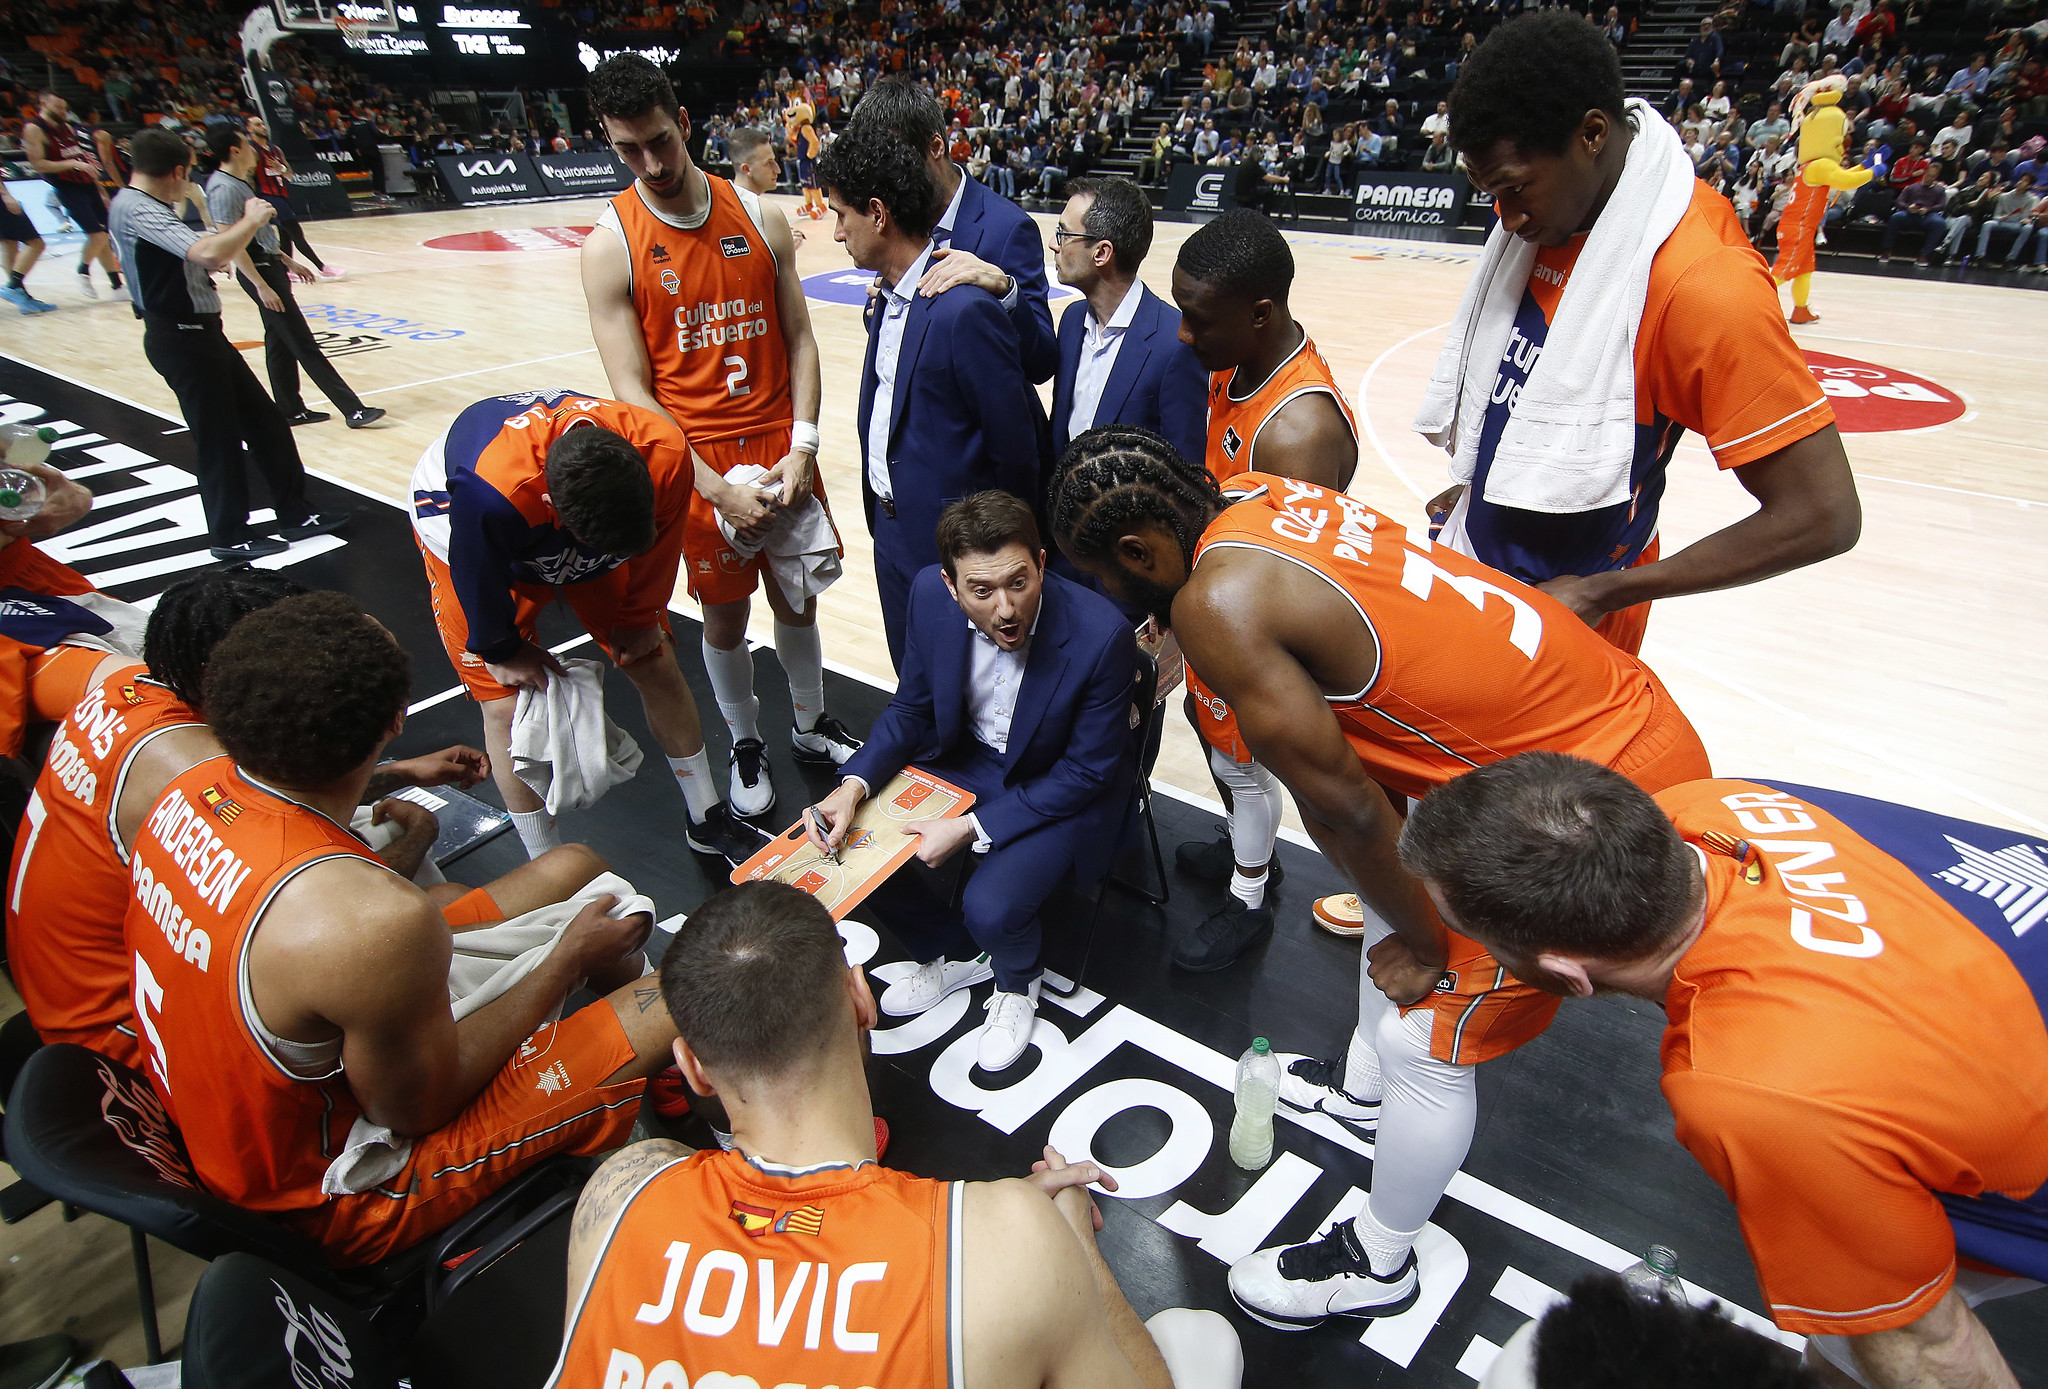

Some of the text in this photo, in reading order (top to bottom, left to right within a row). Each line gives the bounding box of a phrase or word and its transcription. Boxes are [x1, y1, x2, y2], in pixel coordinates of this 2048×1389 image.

[512, 182, 528, 192] Sur
[1355, 184, 1455, 209] PAMESA
[674, 299, 764, 329] Cultura del
[677, 318, 768, 353] Esfuerzo
[723, 355, 751, 398] 2
[147, 788, 252, 915] ANDERSON
[132, 850, 212, 973] PAMESA
[135, 949, 171, 1096] 5
[554, 1057, 573, 1089] luanvi
[634, 1239, 889, 1353] JOVIC
